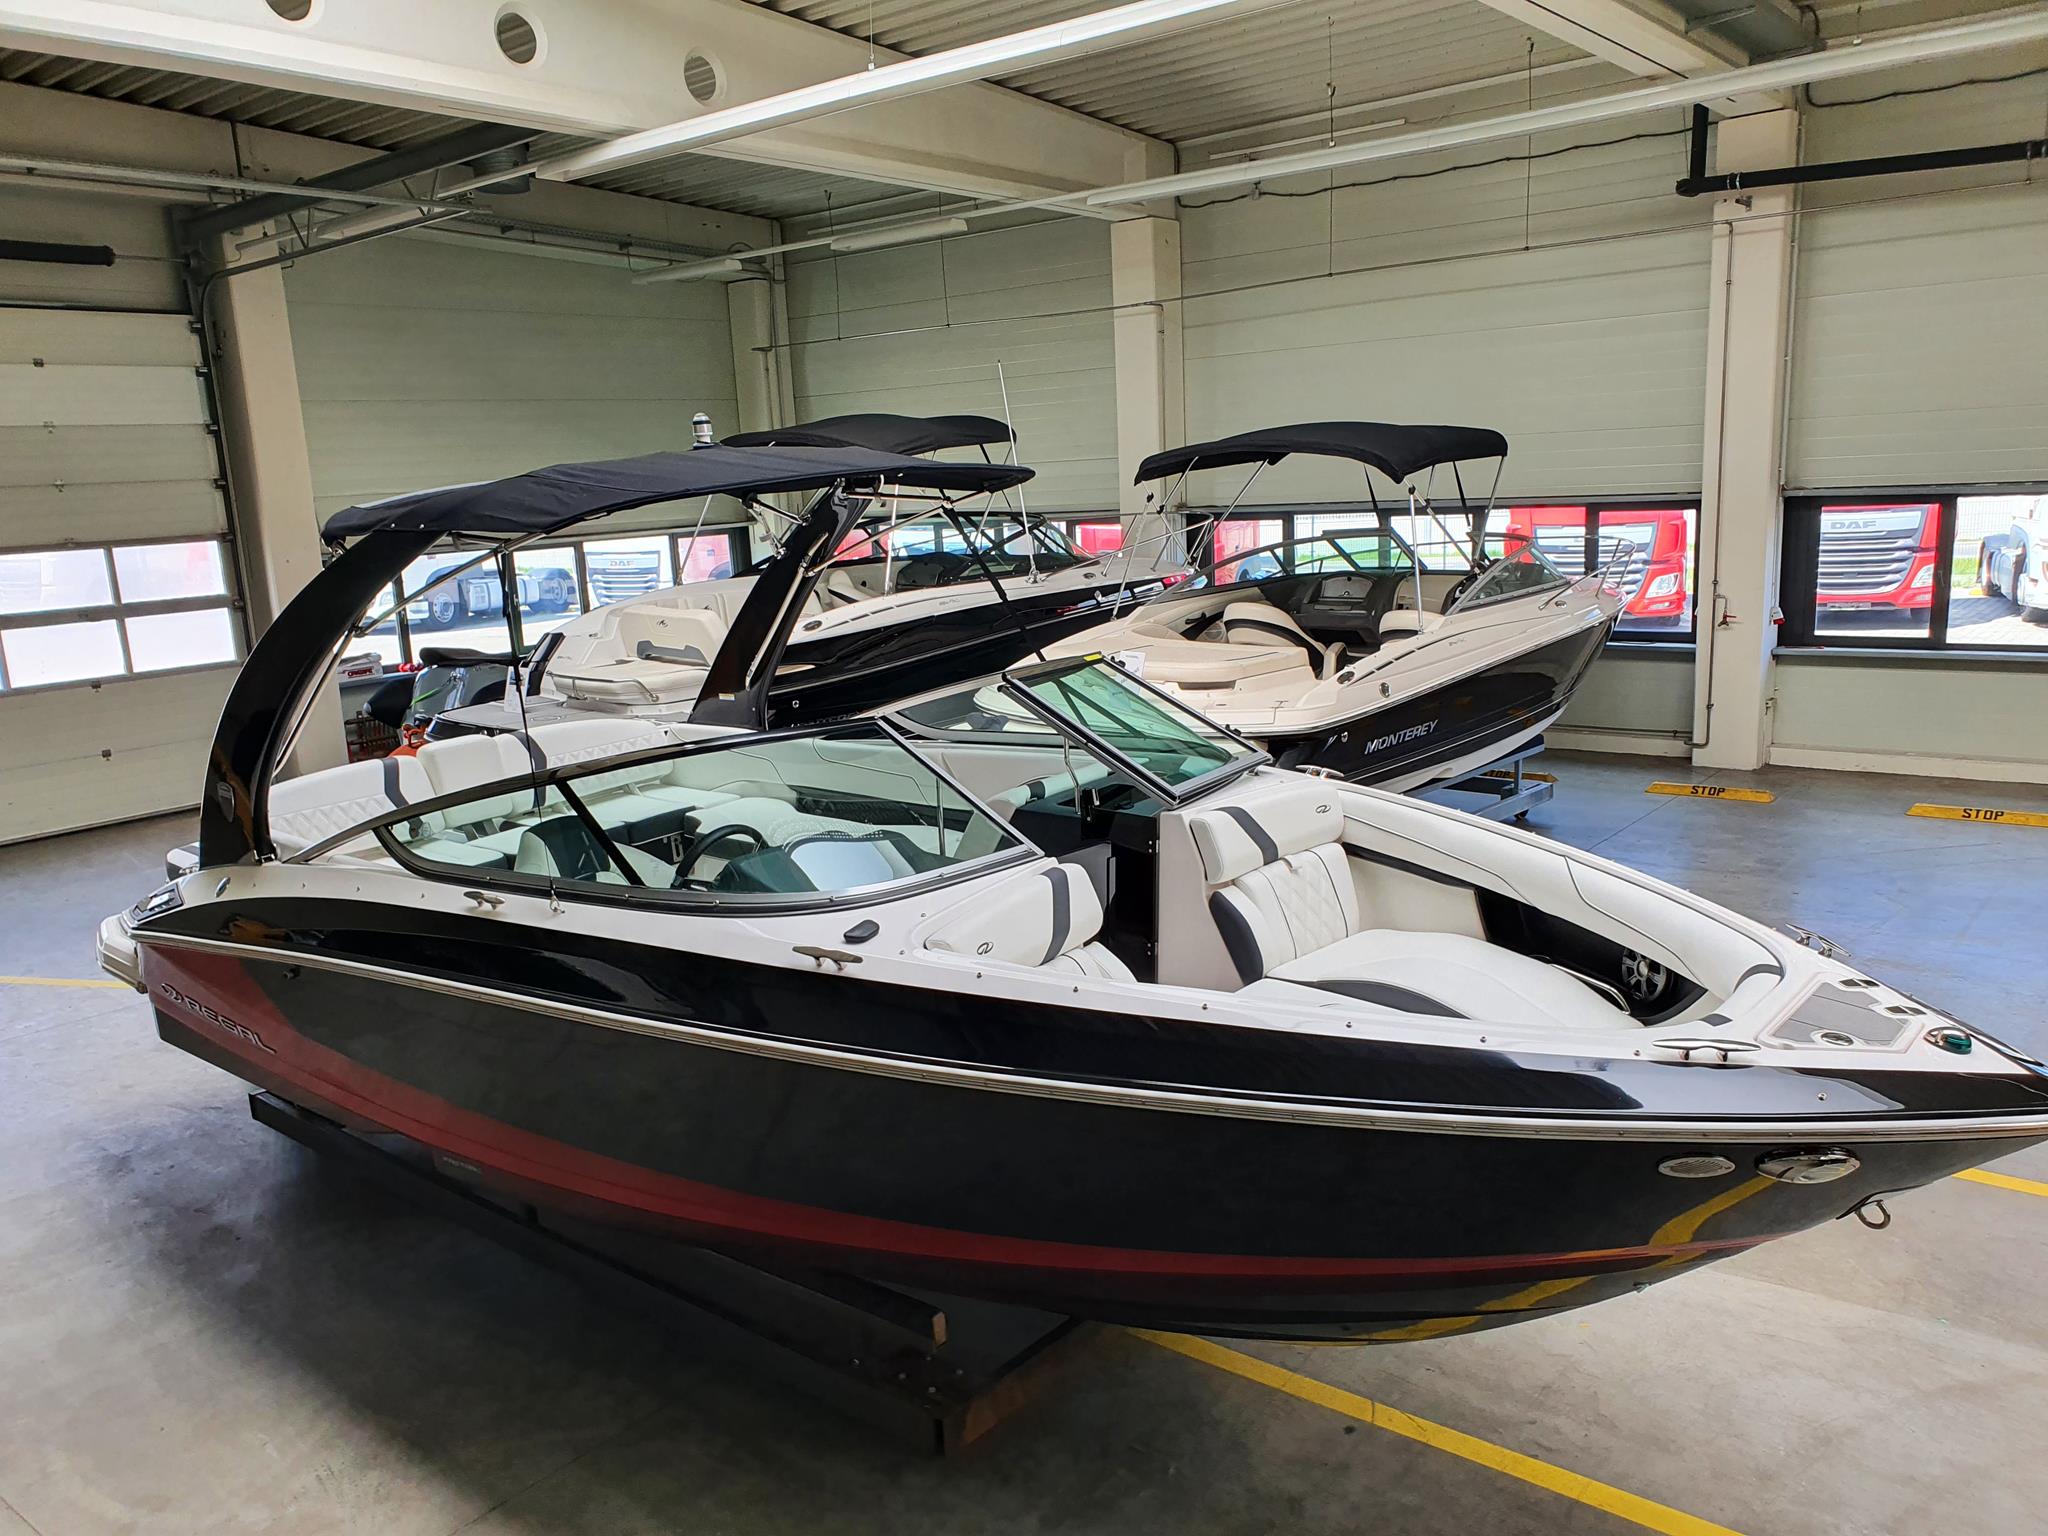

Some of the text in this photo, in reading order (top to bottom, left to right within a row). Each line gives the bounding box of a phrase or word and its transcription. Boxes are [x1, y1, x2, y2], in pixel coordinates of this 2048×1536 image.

[1830, 520, 1877, 530] DAF
[1363, 718, 1439, 755] MONTEREY
[1690, 785, 1726, 797] STOP
[1961, 807, 2005, 820] STOP
[184, 994, 278, 1055] REGAL
